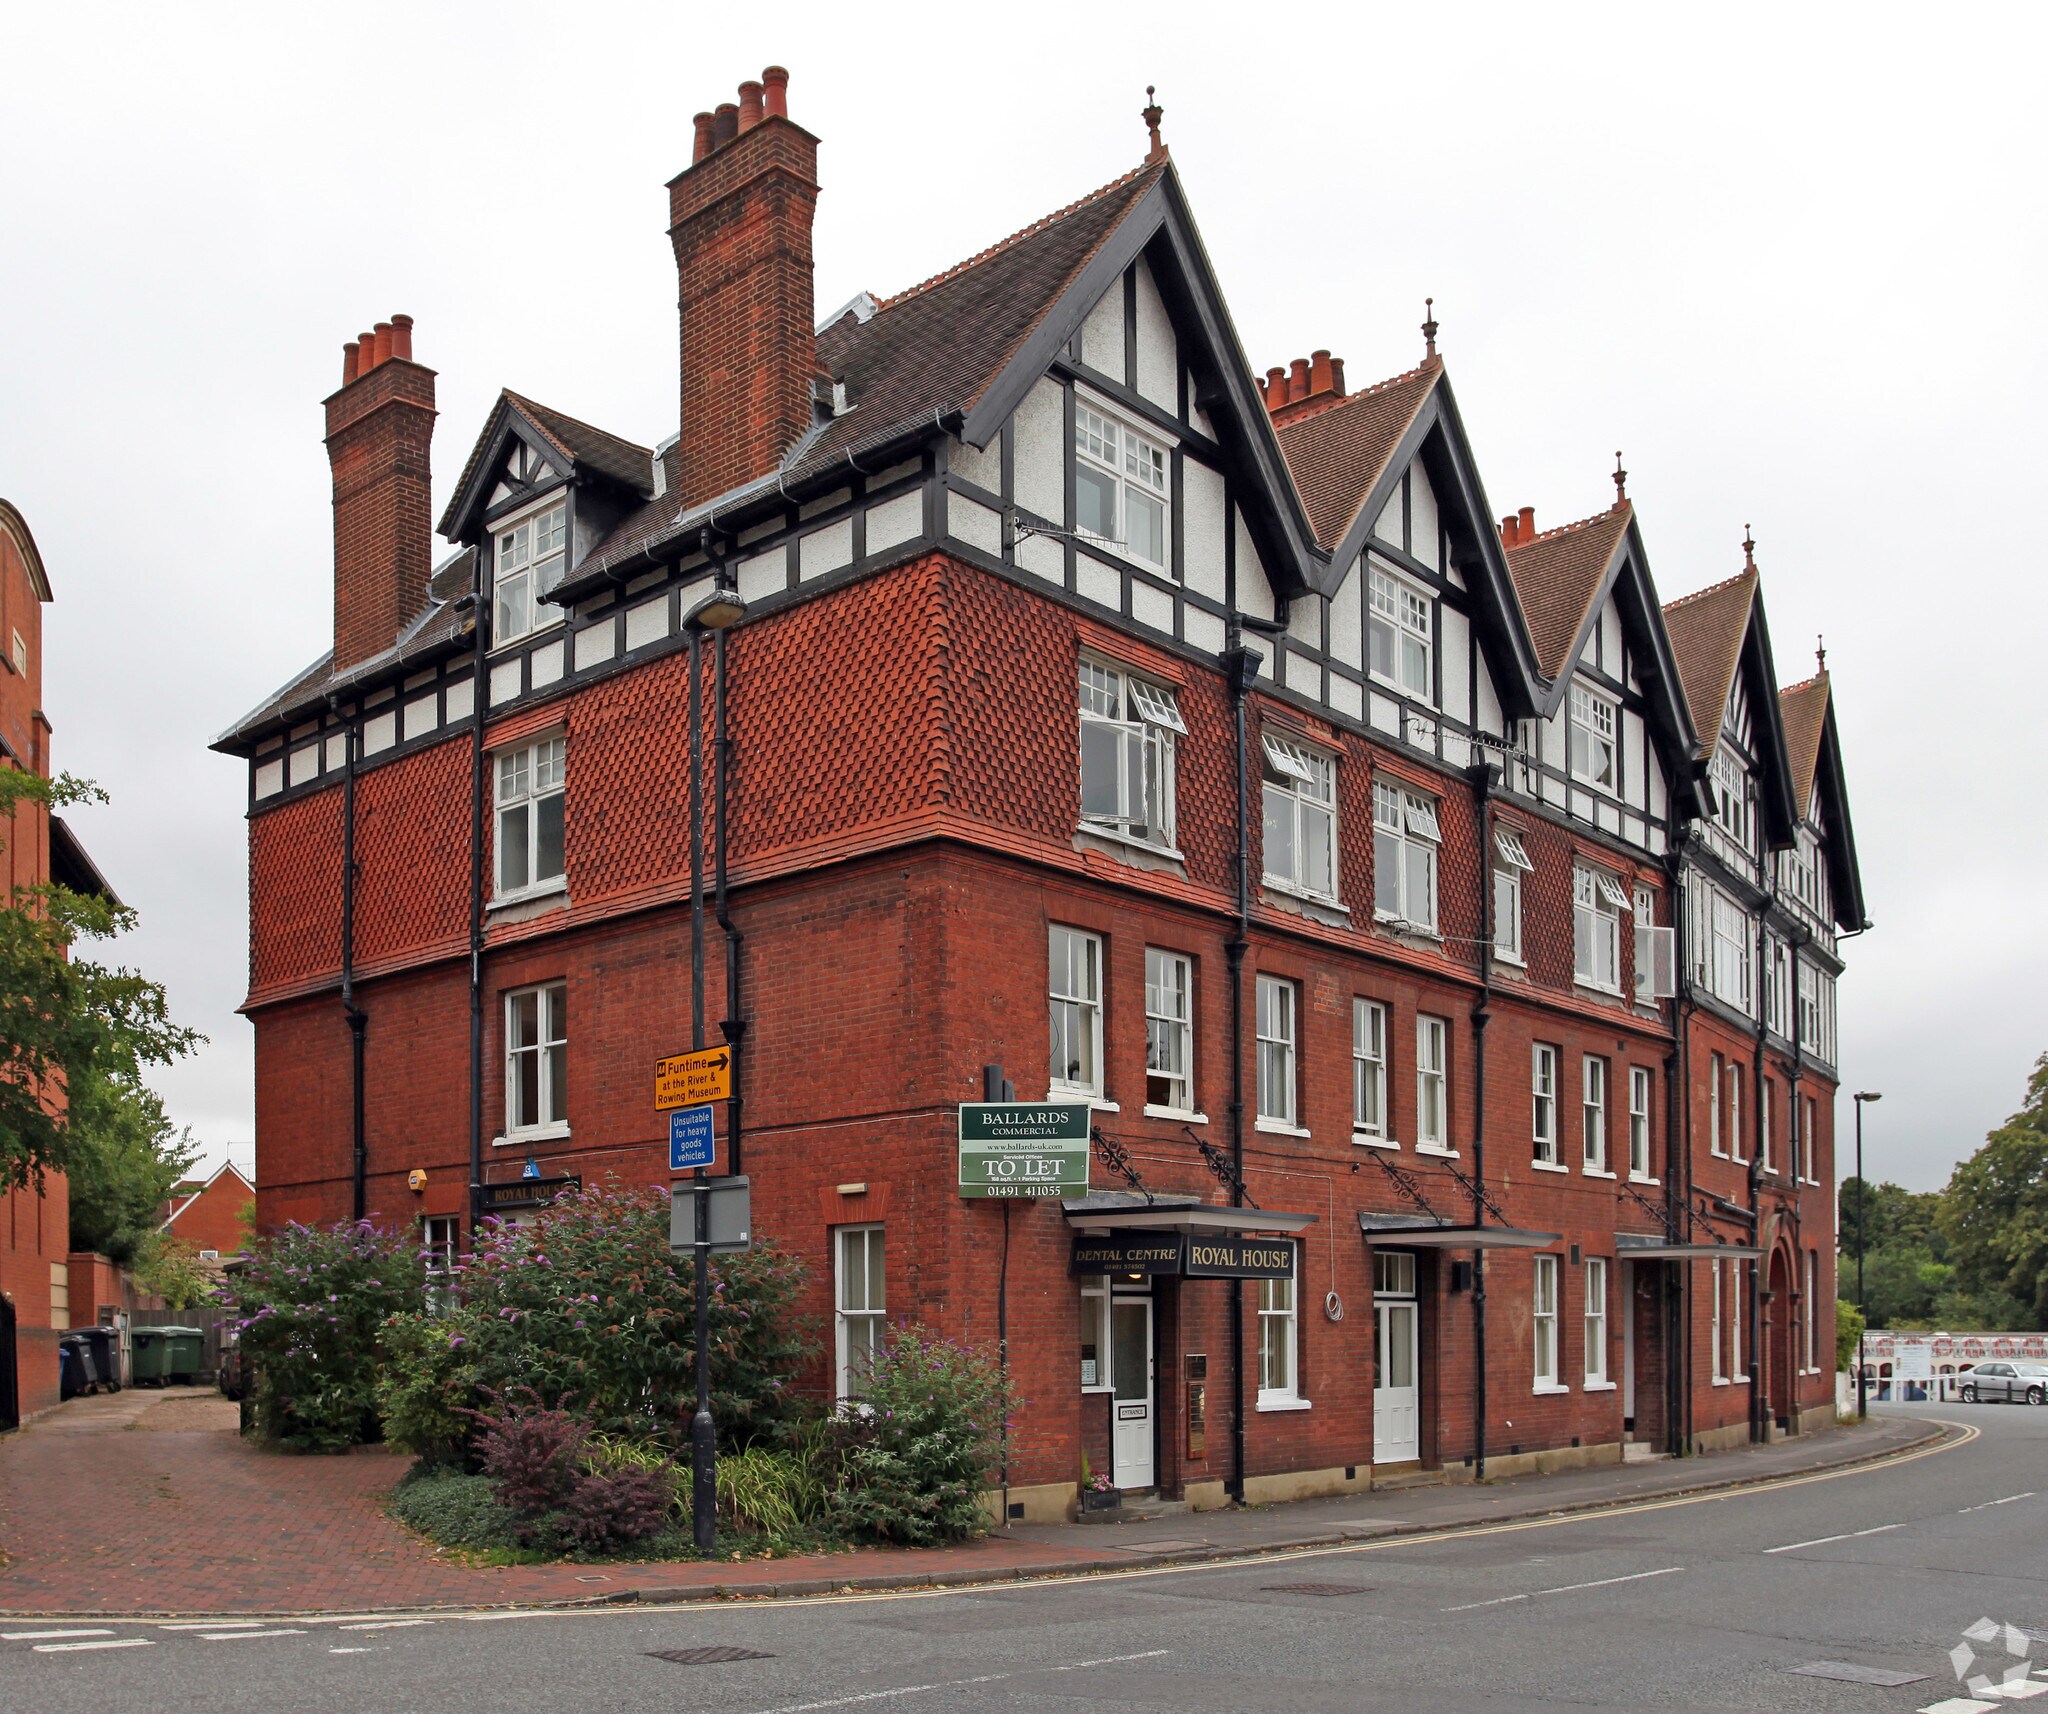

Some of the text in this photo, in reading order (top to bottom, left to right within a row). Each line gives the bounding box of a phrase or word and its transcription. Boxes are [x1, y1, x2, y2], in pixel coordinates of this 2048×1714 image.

[668, 1059, 707, 1075] Funtime
[663, 1072, 716, 1091] at the River &
[658, 1086, 721, 1105] Rowing Museum
[673, 1112, 710, 1127] Unsuitable
[982, 1111, 1069, 1125] BALLARDS
[675, 1126, 708, 1139] for heavy
[992, 1127, 1059, 1136] COMMERCIAL
[680, 1137, 702, 1152] goods
[987, 1143, 1063, 1151] www.ballards-uk.com
[677, 1150, 706, 1162] vehicles
[982, 1159, 1066, 1176] TO LET
[495, 1187, 529, 1202] ROYAL
[987, 1186, 1061, 1196] 01491 411055
[1076, 1249, 1177, 1262] DENTAL CENTRE
[1192, 1246, 1290, 1269] ROYAL HOUSE
